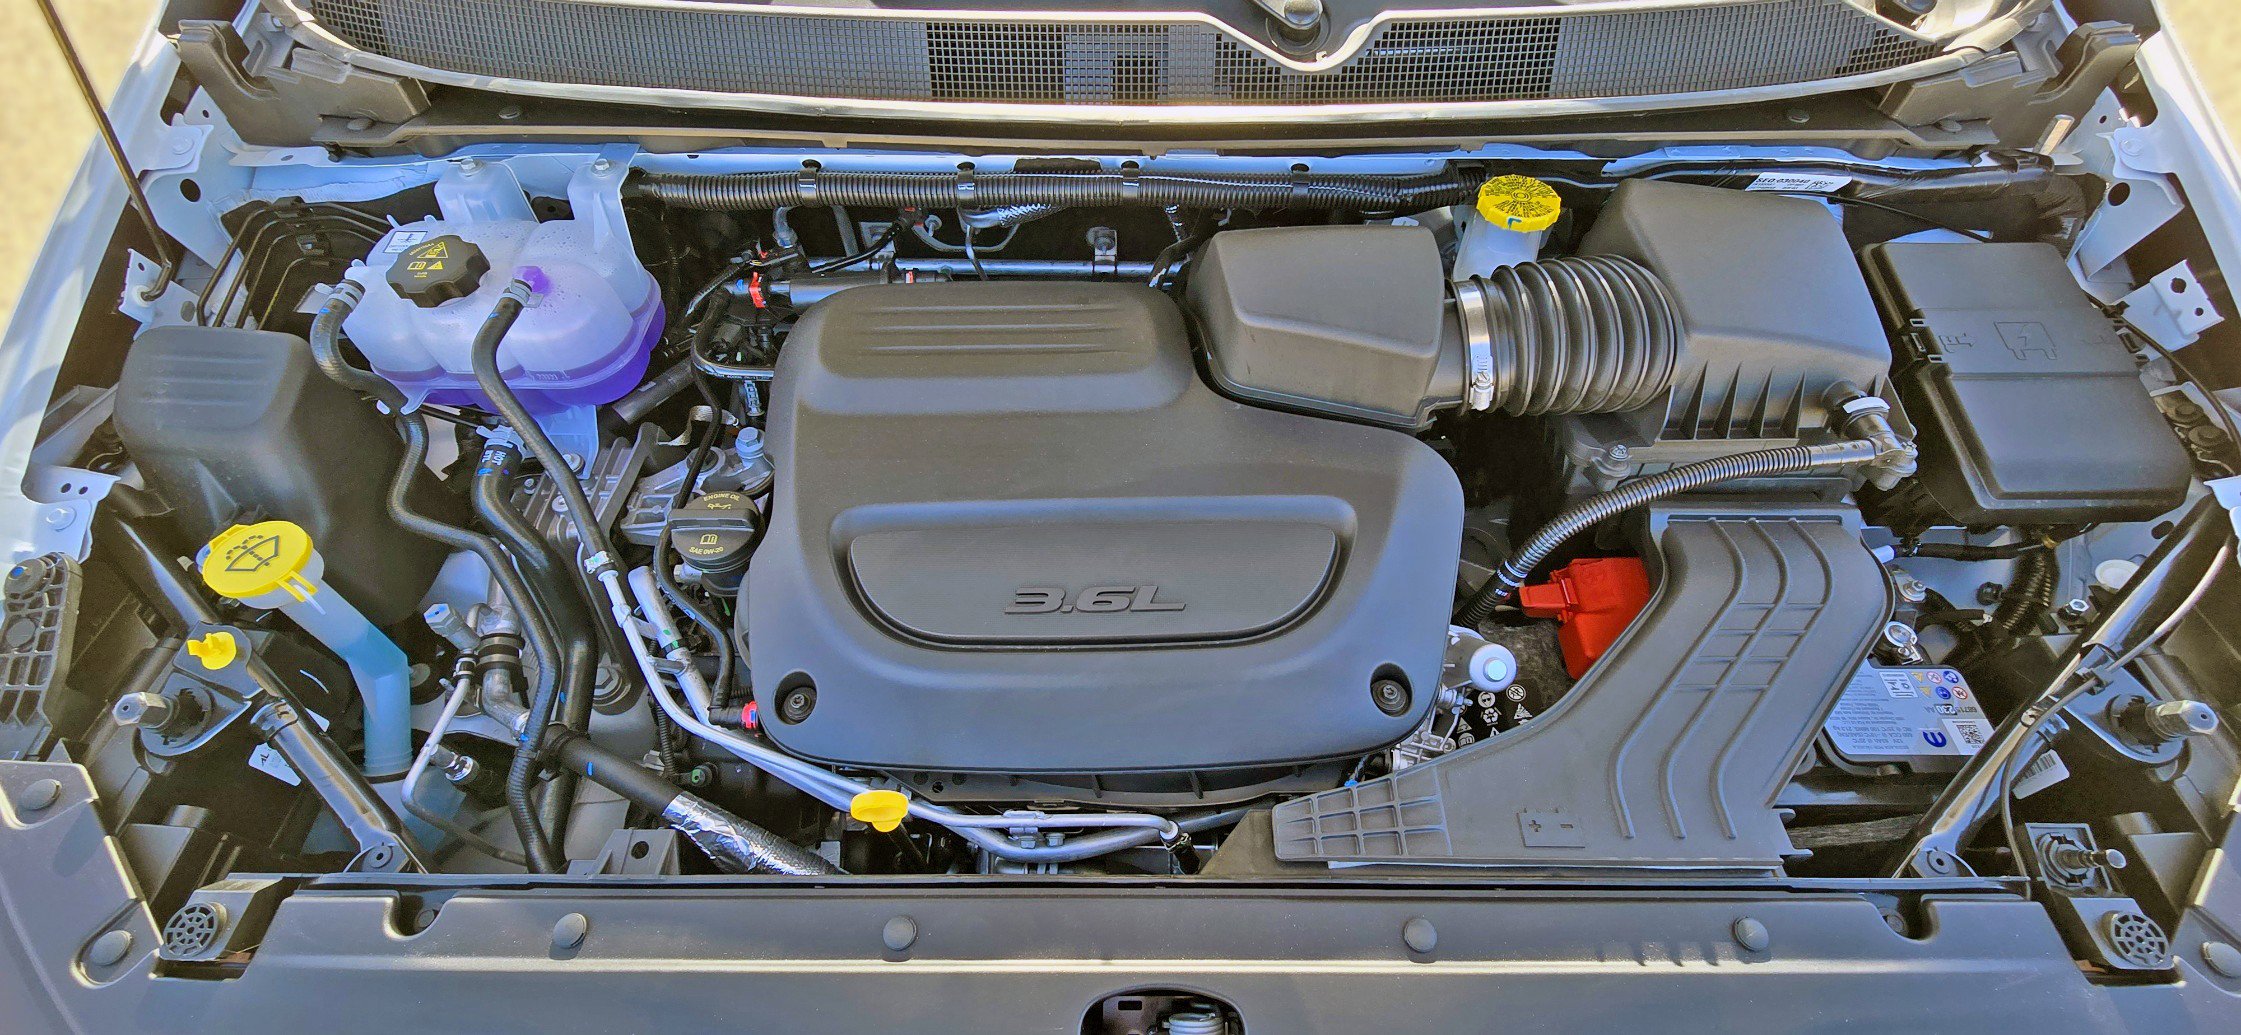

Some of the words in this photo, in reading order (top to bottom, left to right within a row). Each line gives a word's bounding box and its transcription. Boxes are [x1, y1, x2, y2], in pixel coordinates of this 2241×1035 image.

[704, 493, 729, 502] ENGINE
[730, 494, 740, 502] OIL
[689, 546, 703, 555] SAE
[703, 546, 724, 555] 0W-20
[1004, 585, 1187, 615] 3.6L
